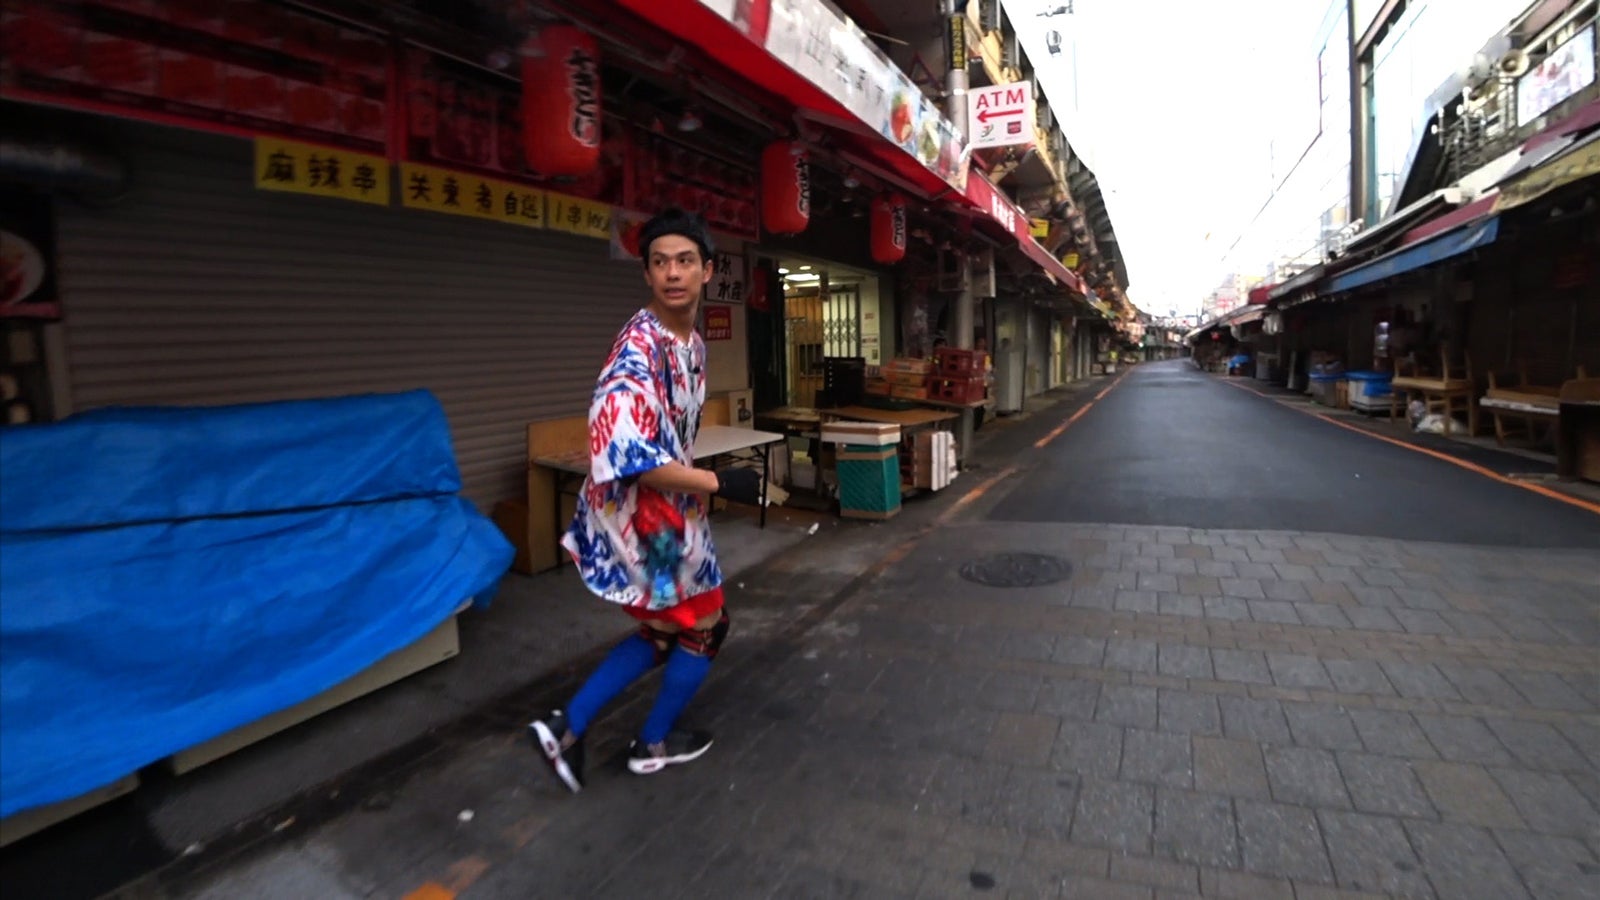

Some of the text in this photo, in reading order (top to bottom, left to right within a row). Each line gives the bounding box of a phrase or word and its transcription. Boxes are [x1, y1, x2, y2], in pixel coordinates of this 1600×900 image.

[976, 88, 1024, 110] ATM
[263, 149, 377, 194] 麻辣串
